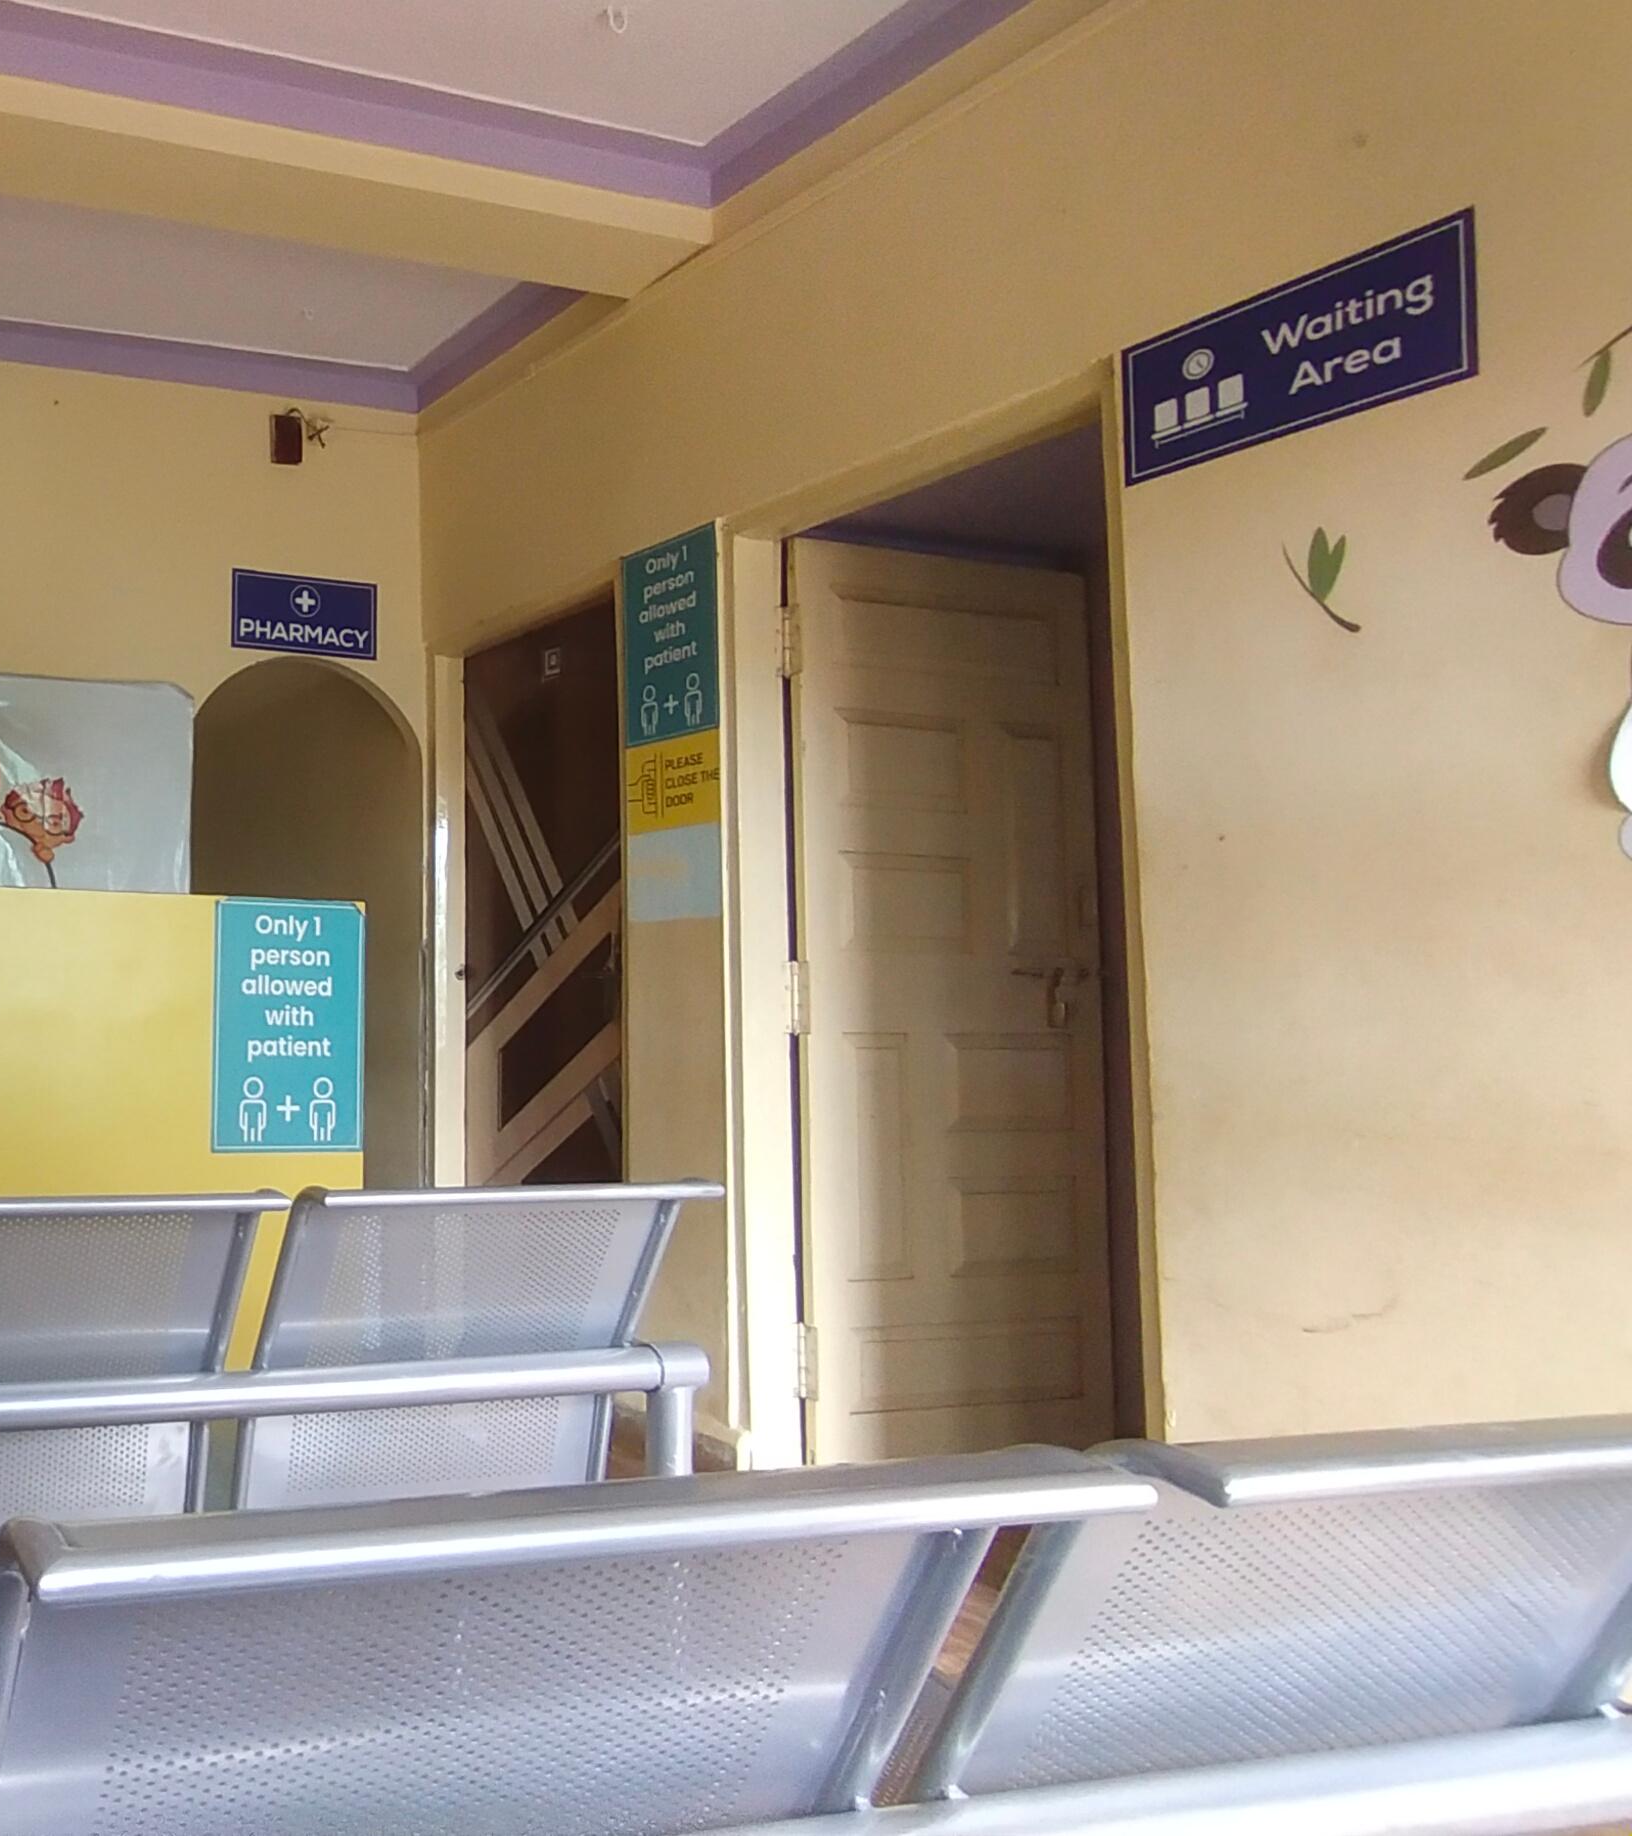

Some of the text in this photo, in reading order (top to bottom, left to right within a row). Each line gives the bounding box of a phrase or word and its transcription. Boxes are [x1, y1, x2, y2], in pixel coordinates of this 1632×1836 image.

[1261, 273, 1435, 355] Waiting
[1288, 336, 1402, 395] Area
[645, 545, 688, 574] Only 1
[643, 570, 695, 604] person
[638, 591, 697, 624] allowed
[239, 618, 369, 648] PHARMACY
[653, 621, 686, 643] with
[644, 642, 697, 674] patient
[665, 752, 703, 769] PLEASE
[666, 768, 720, 789] CLOSE THE
[666, 793, 694, 807] DOOR
[255, 915, 321, 942] Only 1
[250, 949, 331, 970] person
[241, 975, 333, 996] allowed
[265, 1005, 314, 1026] with
[247, 1036, 331, 1062] patient
